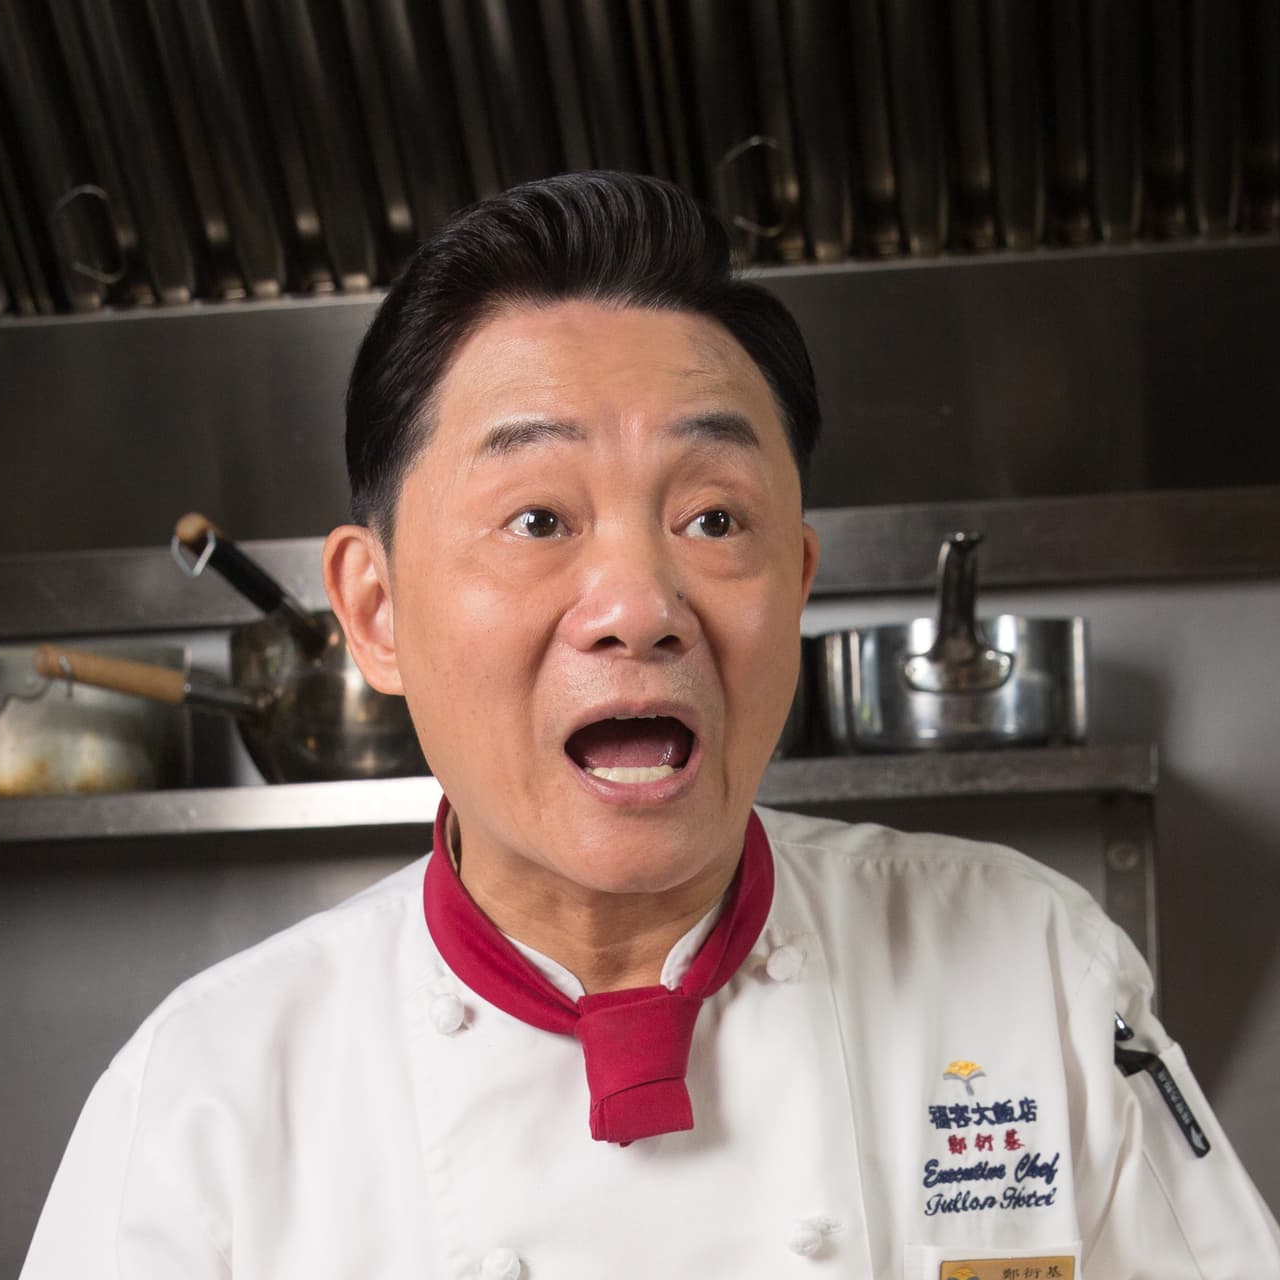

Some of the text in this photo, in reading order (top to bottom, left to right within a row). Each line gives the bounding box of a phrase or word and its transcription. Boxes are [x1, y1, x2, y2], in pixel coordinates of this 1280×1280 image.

[923, 1152, 1060, 1188] Executive Chef
[1000, 1187, 1057, 1209] Hotel
